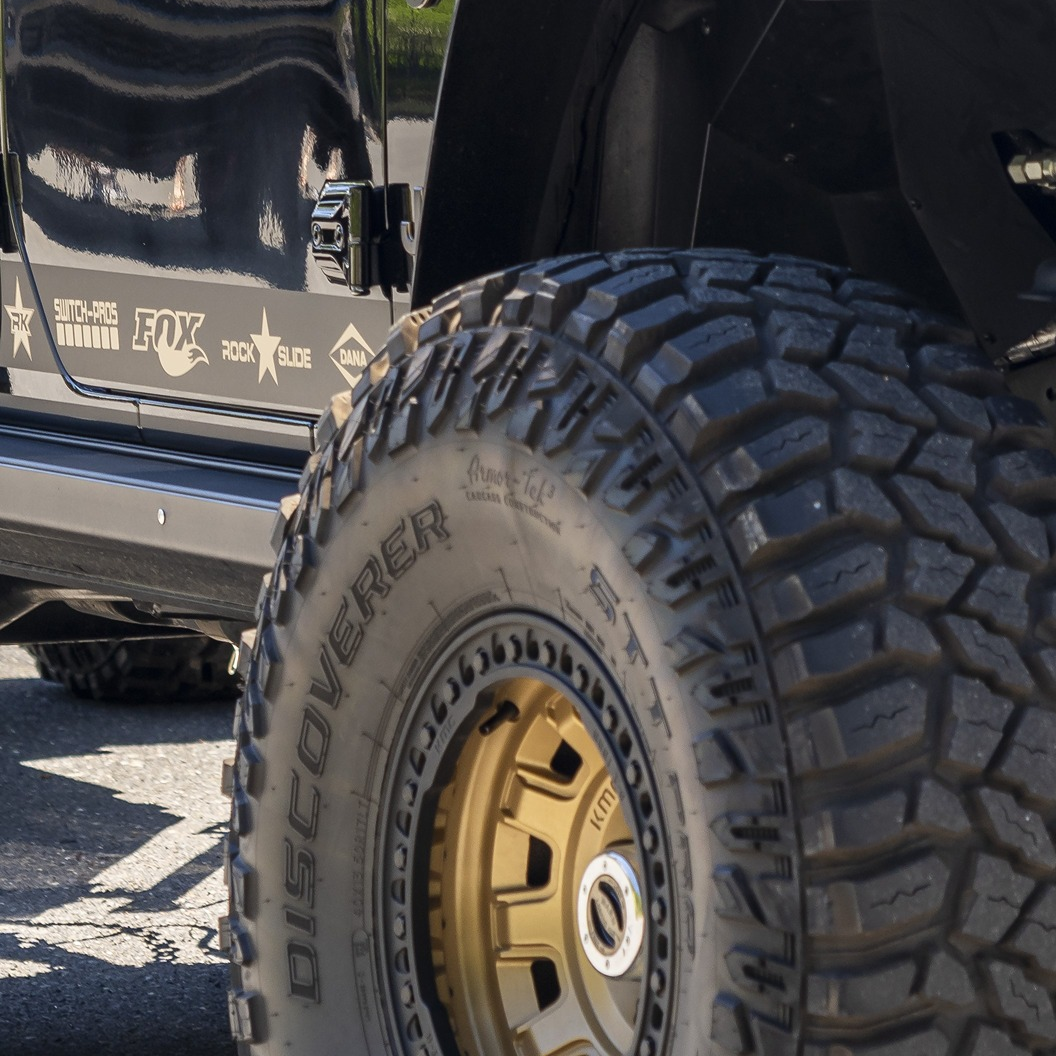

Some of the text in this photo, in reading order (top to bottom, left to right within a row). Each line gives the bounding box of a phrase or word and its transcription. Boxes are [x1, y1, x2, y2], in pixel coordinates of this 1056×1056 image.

[54, 298, 119, 325] SWITCH-PROS
[132, 308, 206, 353] FOX
[221, 340, 312, 369] ROCK SLIDE
[339, 348, 368, 367] DANA
[283, 499, 451, 1004] DISCOVERER
